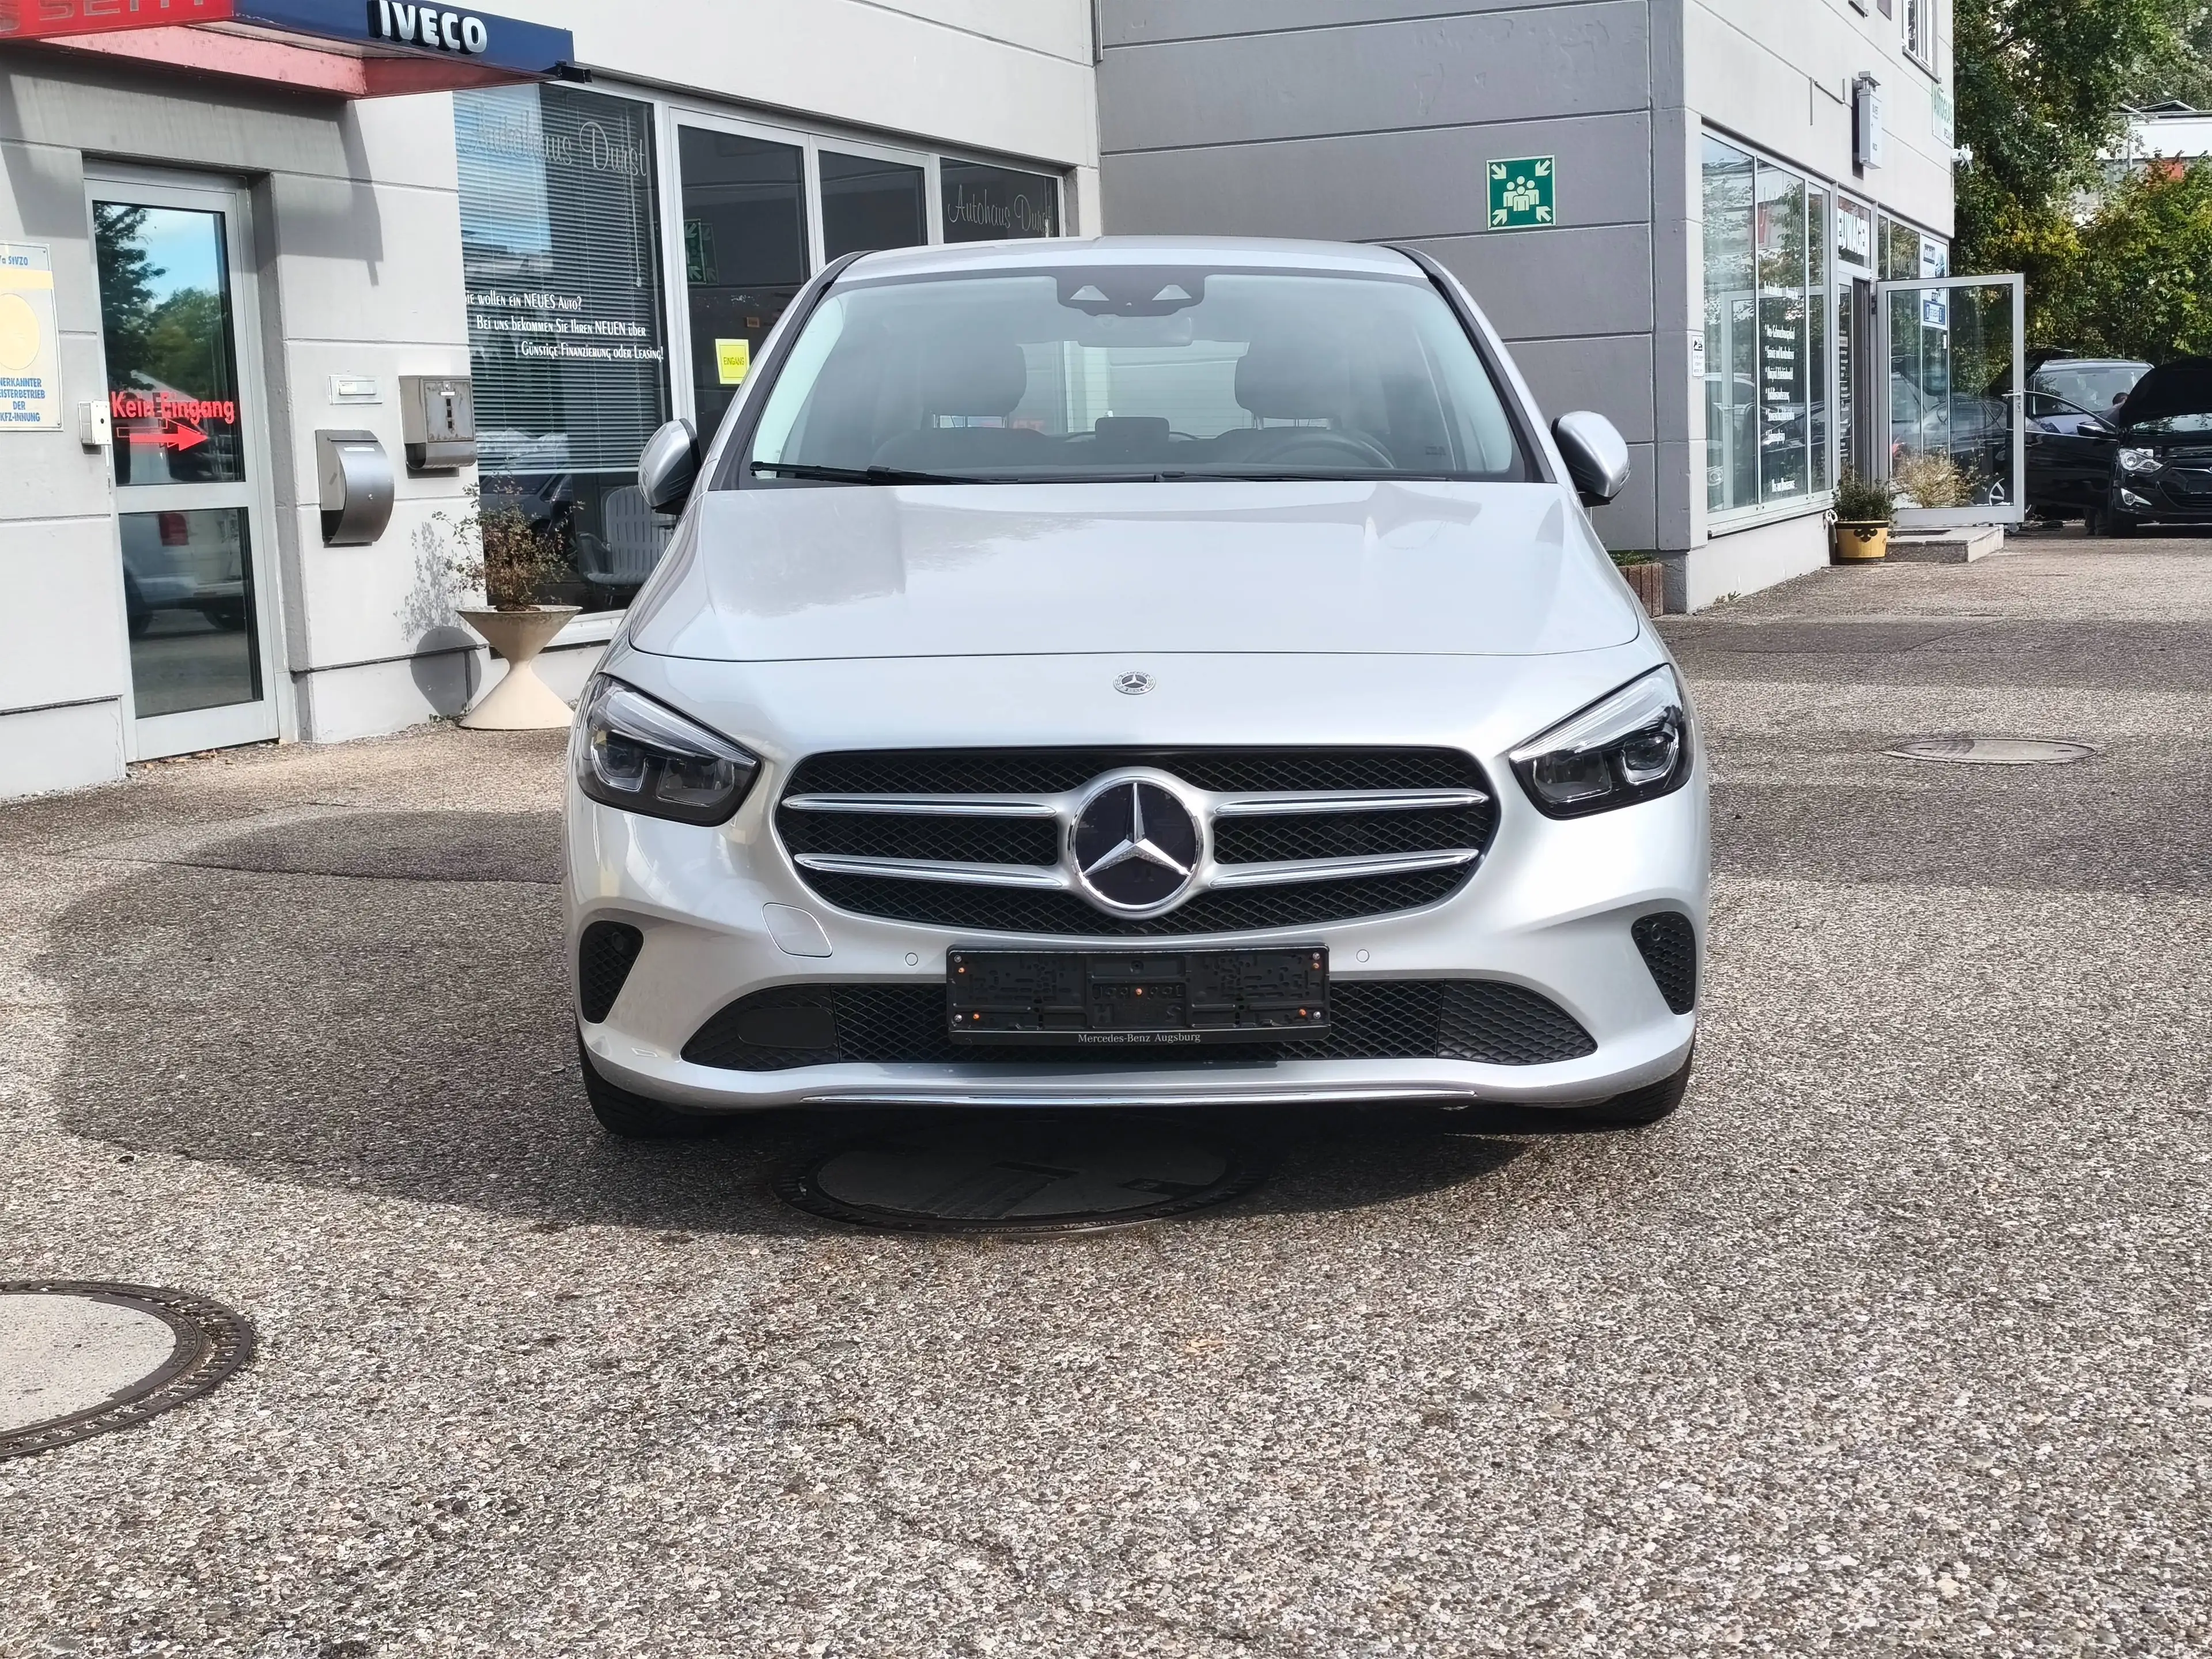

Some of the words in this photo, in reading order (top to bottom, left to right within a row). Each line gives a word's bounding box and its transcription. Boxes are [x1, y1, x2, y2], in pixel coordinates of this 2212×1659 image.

[380, 0, 487, 53] IVECO
[948, 184, 1011, 229] Autohaus
[1838, 207, 1869, 257] EUWAGEN
[9, 256, 28, 266] StVZO
[478, 290, 506, 306] wollen
[524, 293, 555, 309] NEUES
[558, 296, 582, 311] Auto?
[477, 315, 491, 329] Bei
[511, 315, 553, 332] bekommen
[556, 318, 568, 333] Sie
[571, 319, 592, 334] Ihren
[595, 320, 626, 335] NEUEN
[560, 342, 611, 361] Finanzierung
[613, 344, 632, 359] oder
[724, 357, 745, 366] EINGANG
[13, 401, 25, 410] DER
[111, 391, 154, 418] Kein
[160, 392, 234, 424] Eingang
[1078, 1033, 1150, 1043] Mercedes-Benz
[1154, 1033, 1201, 1043] Augsburg
